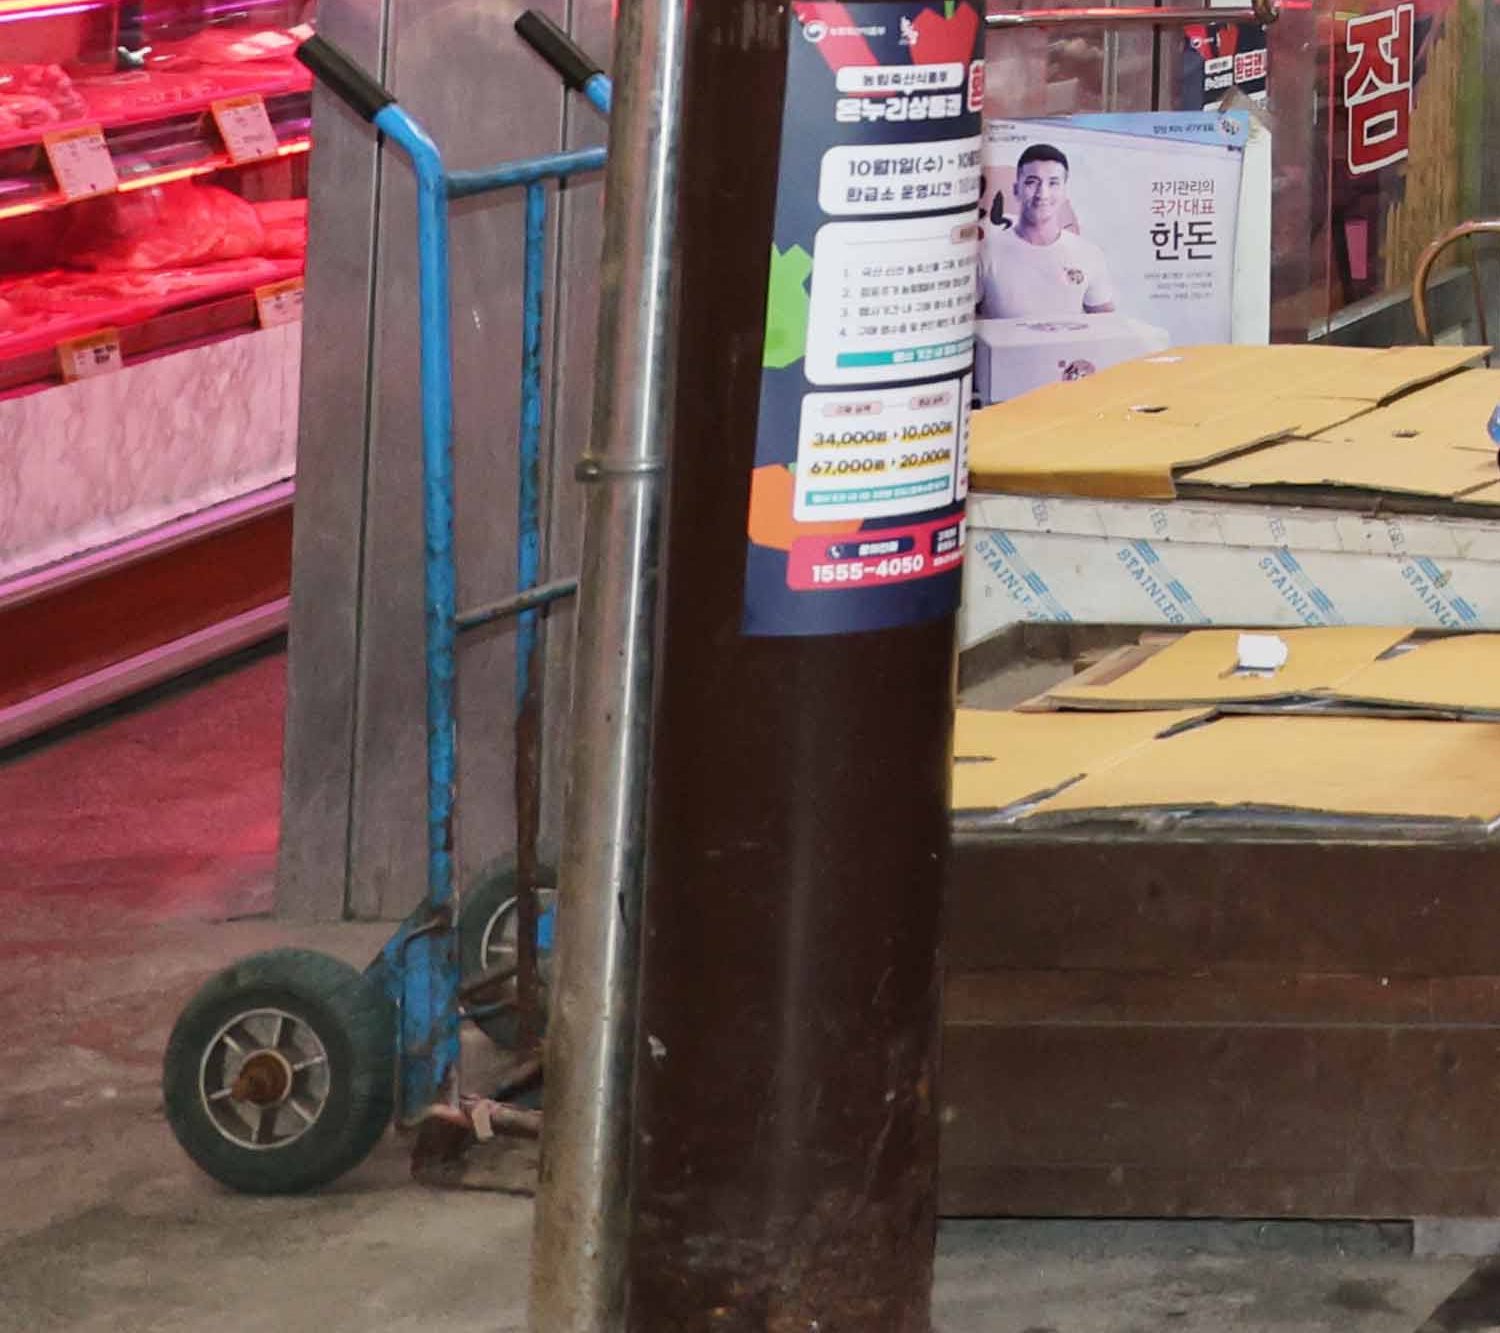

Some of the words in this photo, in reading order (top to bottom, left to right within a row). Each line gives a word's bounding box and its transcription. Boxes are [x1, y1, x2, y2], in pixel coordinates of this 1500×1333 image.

[835, 92, 963, 123] 온누리상품권
[1151, 180, 1215, 195] 자기관리의
[1151, 198, 1216, 215] 국가대표
[1149, 220, 1217, 261] 한돈
[811, 553, 925, 583] 1555-4050
